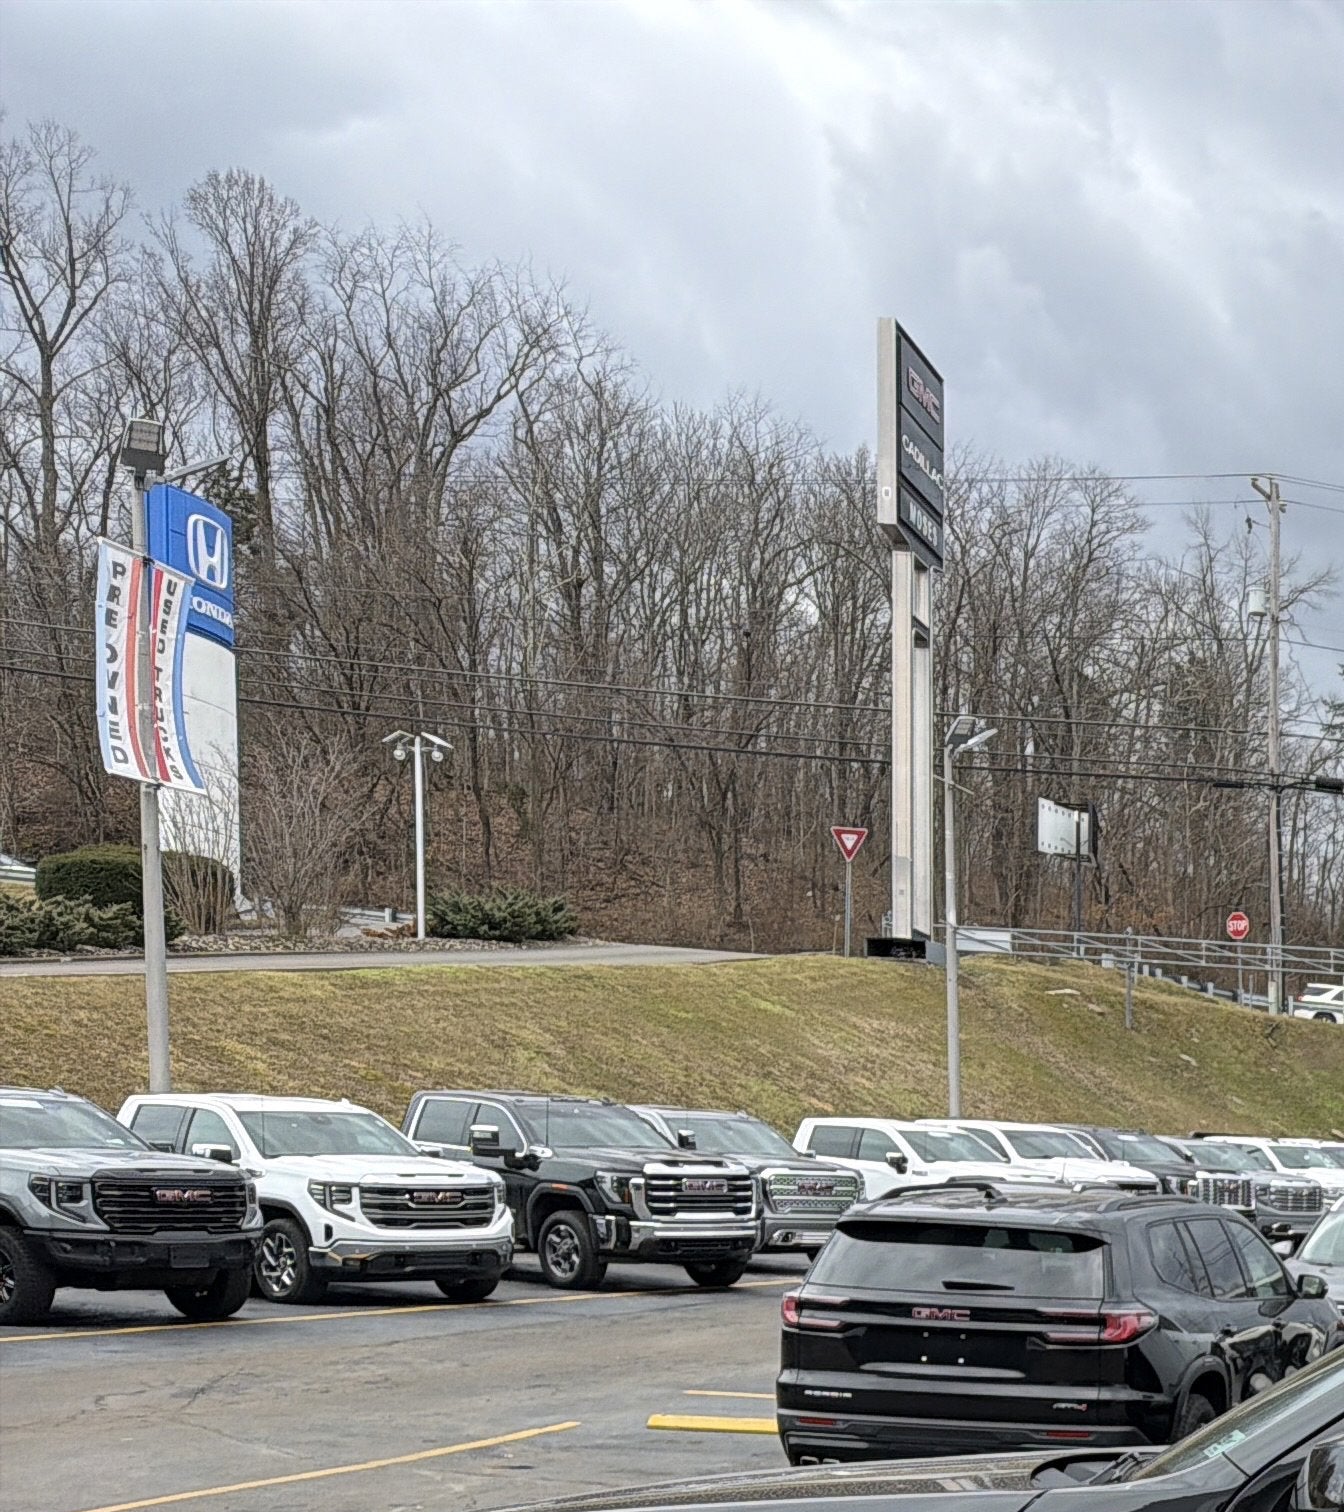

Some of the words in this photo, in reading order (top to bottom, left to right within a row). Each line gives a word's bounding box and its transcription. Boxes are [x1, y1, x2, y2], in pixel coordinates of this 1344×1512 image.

[907, 366, 940, 424] GMC
[902, 434, 944, 490] CADILLAC
[190, 595, 235, 630] ONDA
[1228, 920, 1248, 931] STOP
[156, 1190, 212, 1201] GMC
[912, 1307, 970, 1320] GMC
